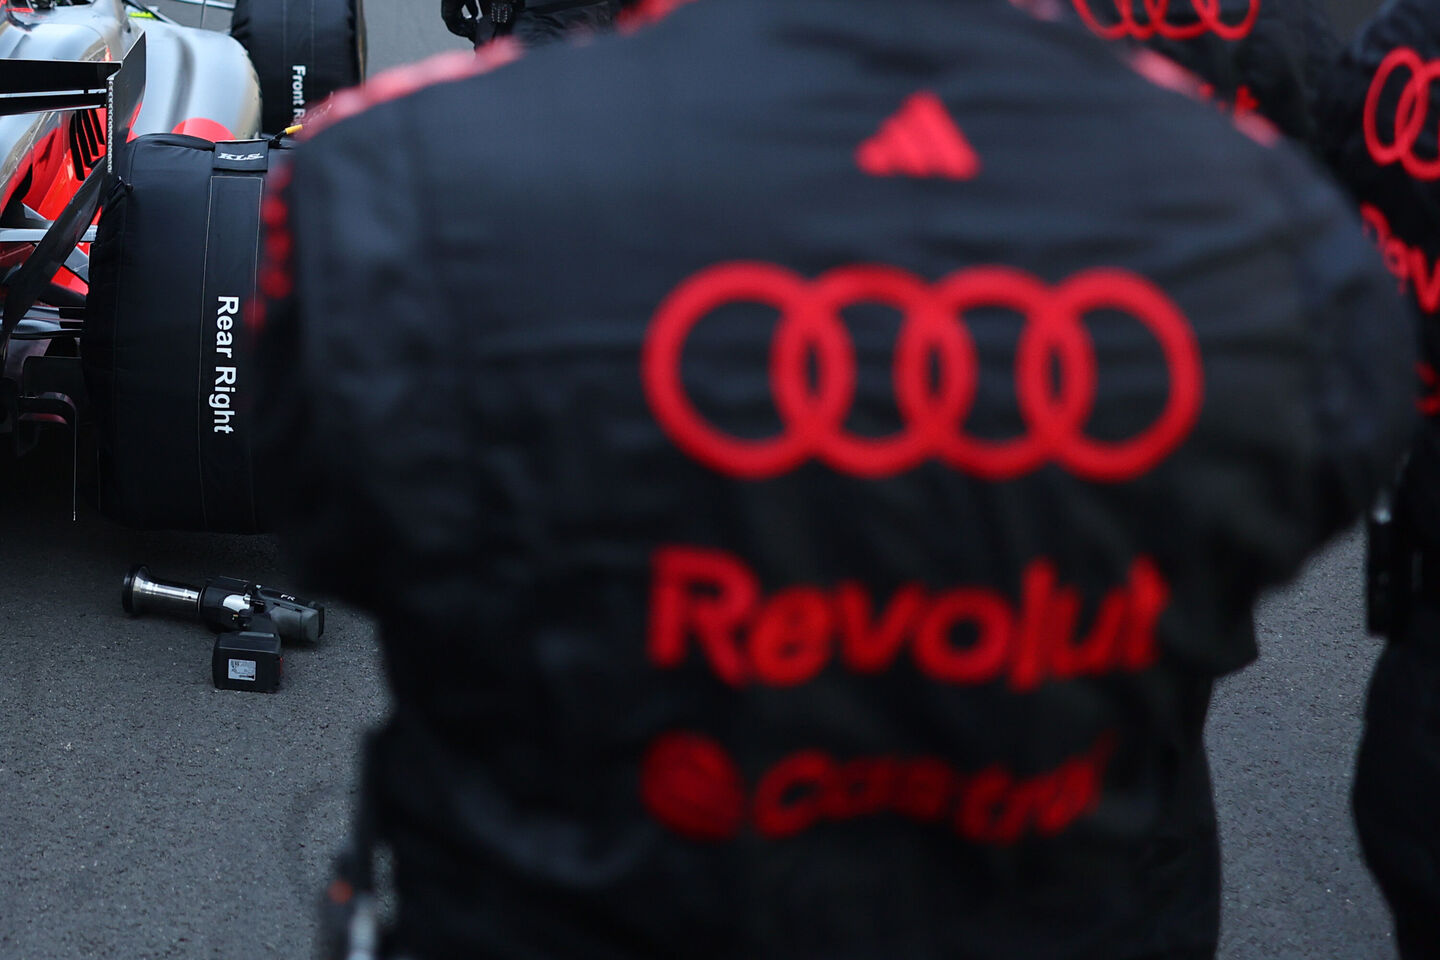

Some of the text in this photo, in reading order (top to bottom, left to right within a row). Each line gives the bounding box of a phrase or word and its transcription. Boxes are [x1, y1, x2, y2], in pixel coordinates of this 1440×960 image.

[292, 65, 307, 106] Front
[217, 152, 264, 161] KLS
[208, 296, 240, 434] Rear Right
[648, 544, 1169, 691] Revolut
